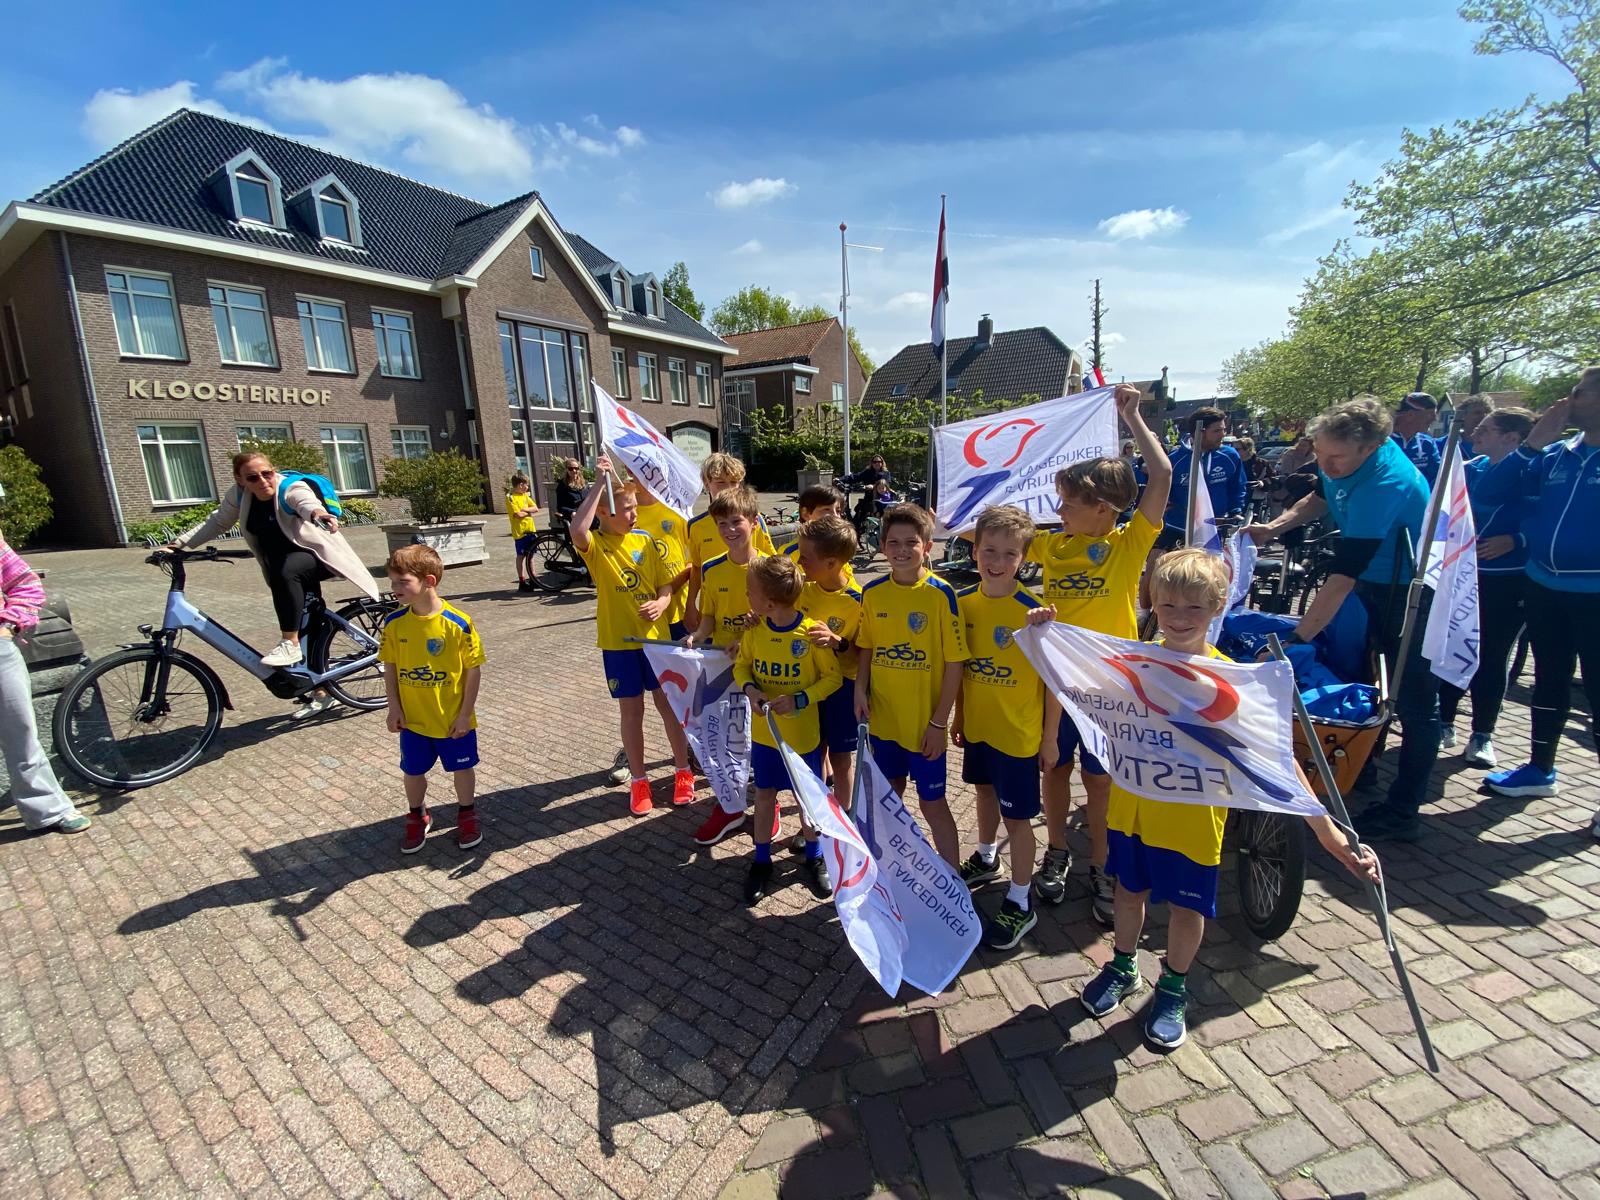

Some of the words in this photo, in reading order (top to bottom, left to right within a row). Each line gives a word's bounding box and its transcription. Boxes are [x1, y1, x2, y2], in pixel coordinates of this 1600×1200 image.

[128, 379, 331, 405] KLOOSTERHOF
[1049, 577, 1106, 590] ROOD
[754, 658, 801, 677] FABIS
